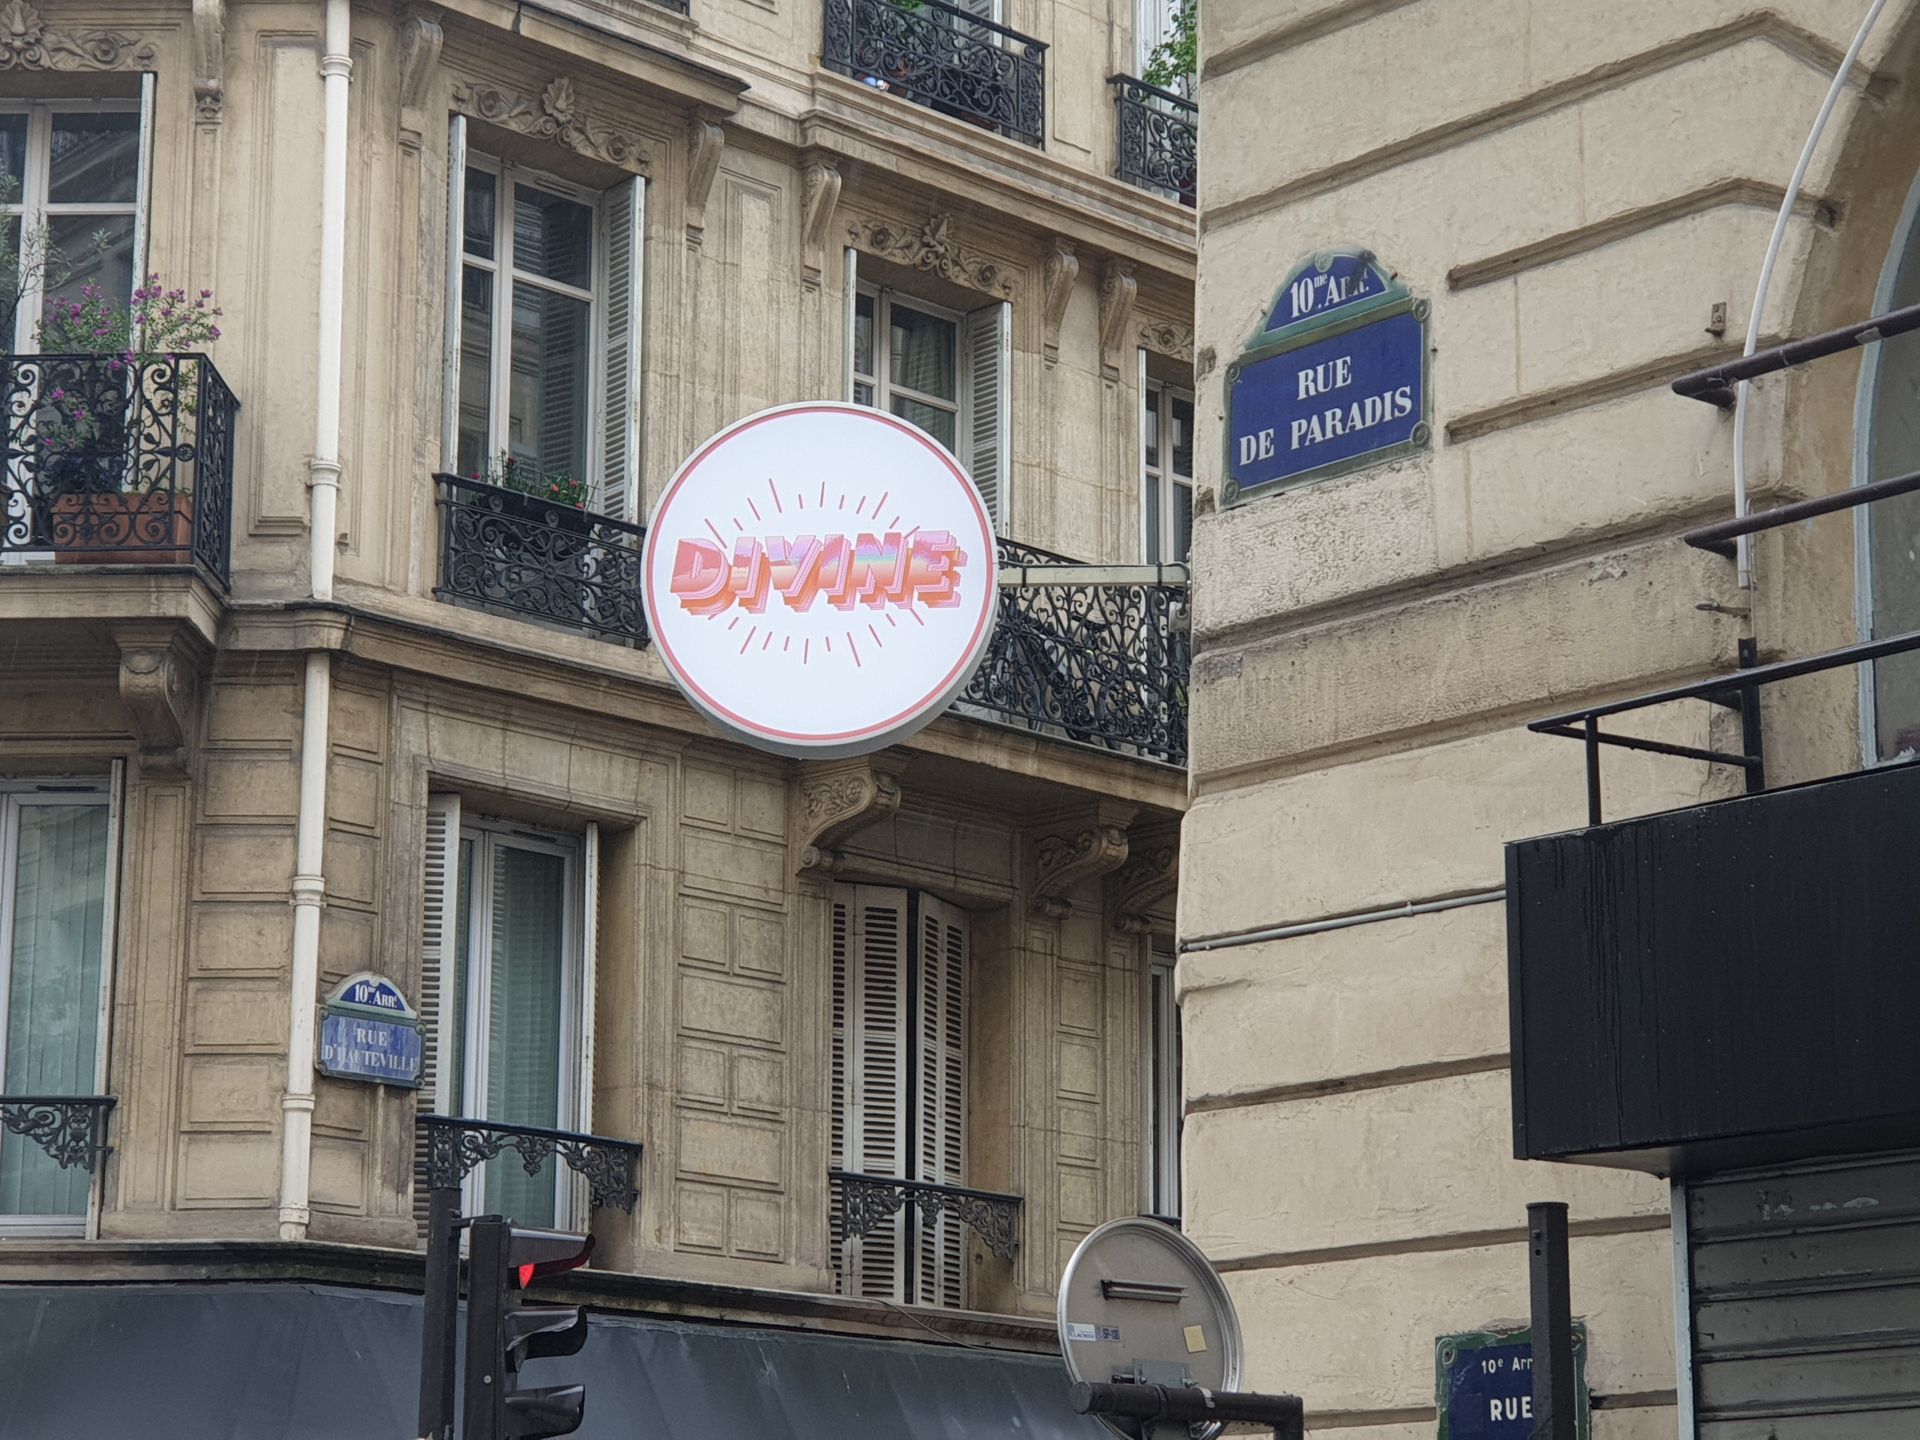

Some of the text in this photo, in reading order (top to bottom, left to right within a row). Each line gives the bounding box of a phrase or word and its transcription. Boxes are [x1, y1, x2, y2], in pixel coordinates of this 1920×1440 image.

[1297, 355, 1352, 400] RUE
[1239, 385, 1412, 465] DE PARADIS
[670, 529, 968, 616] DIVINE
[356, 1028, 387, 1046] RUE
[1481, 1359, 1503, 1374] 10e
[1490, 1396, 1533, 1422] RUE
